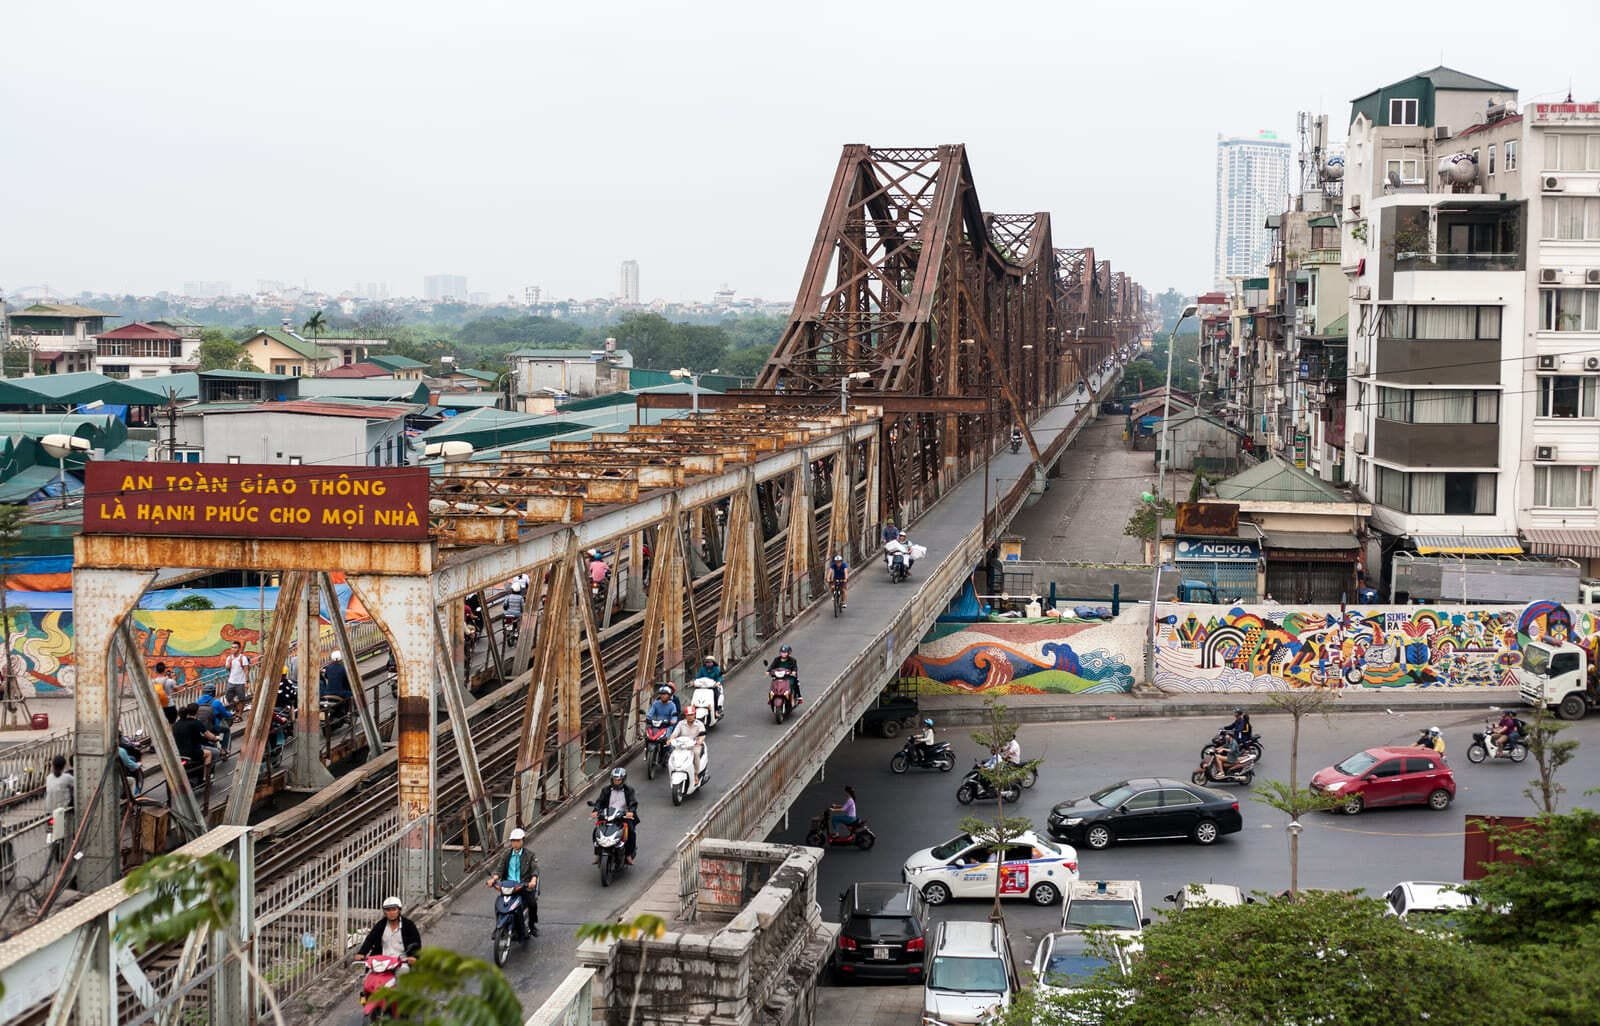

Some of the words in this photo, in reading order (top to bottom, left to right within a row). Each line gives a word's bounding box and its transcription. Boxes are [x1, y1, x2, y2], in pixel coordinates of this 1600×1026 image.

[121, 475, 152, 491] AN
[166, 472, 228, 493] TOÀN
[240, 473, 297, 495] GIAO
[310, 474, 387, 497] THÔNG
[100, 497, 127, 520] LÀ
[138, 504, 196, 525] HẠNH
[205, 498, 259, 523] PHÚC
[269, 507, 312, 525] CHO
[321, 504, 364, 530] MỌI
[374, 502, 420, 527] NHÀ
[1203, 545, 1252, 553] NOKIA
